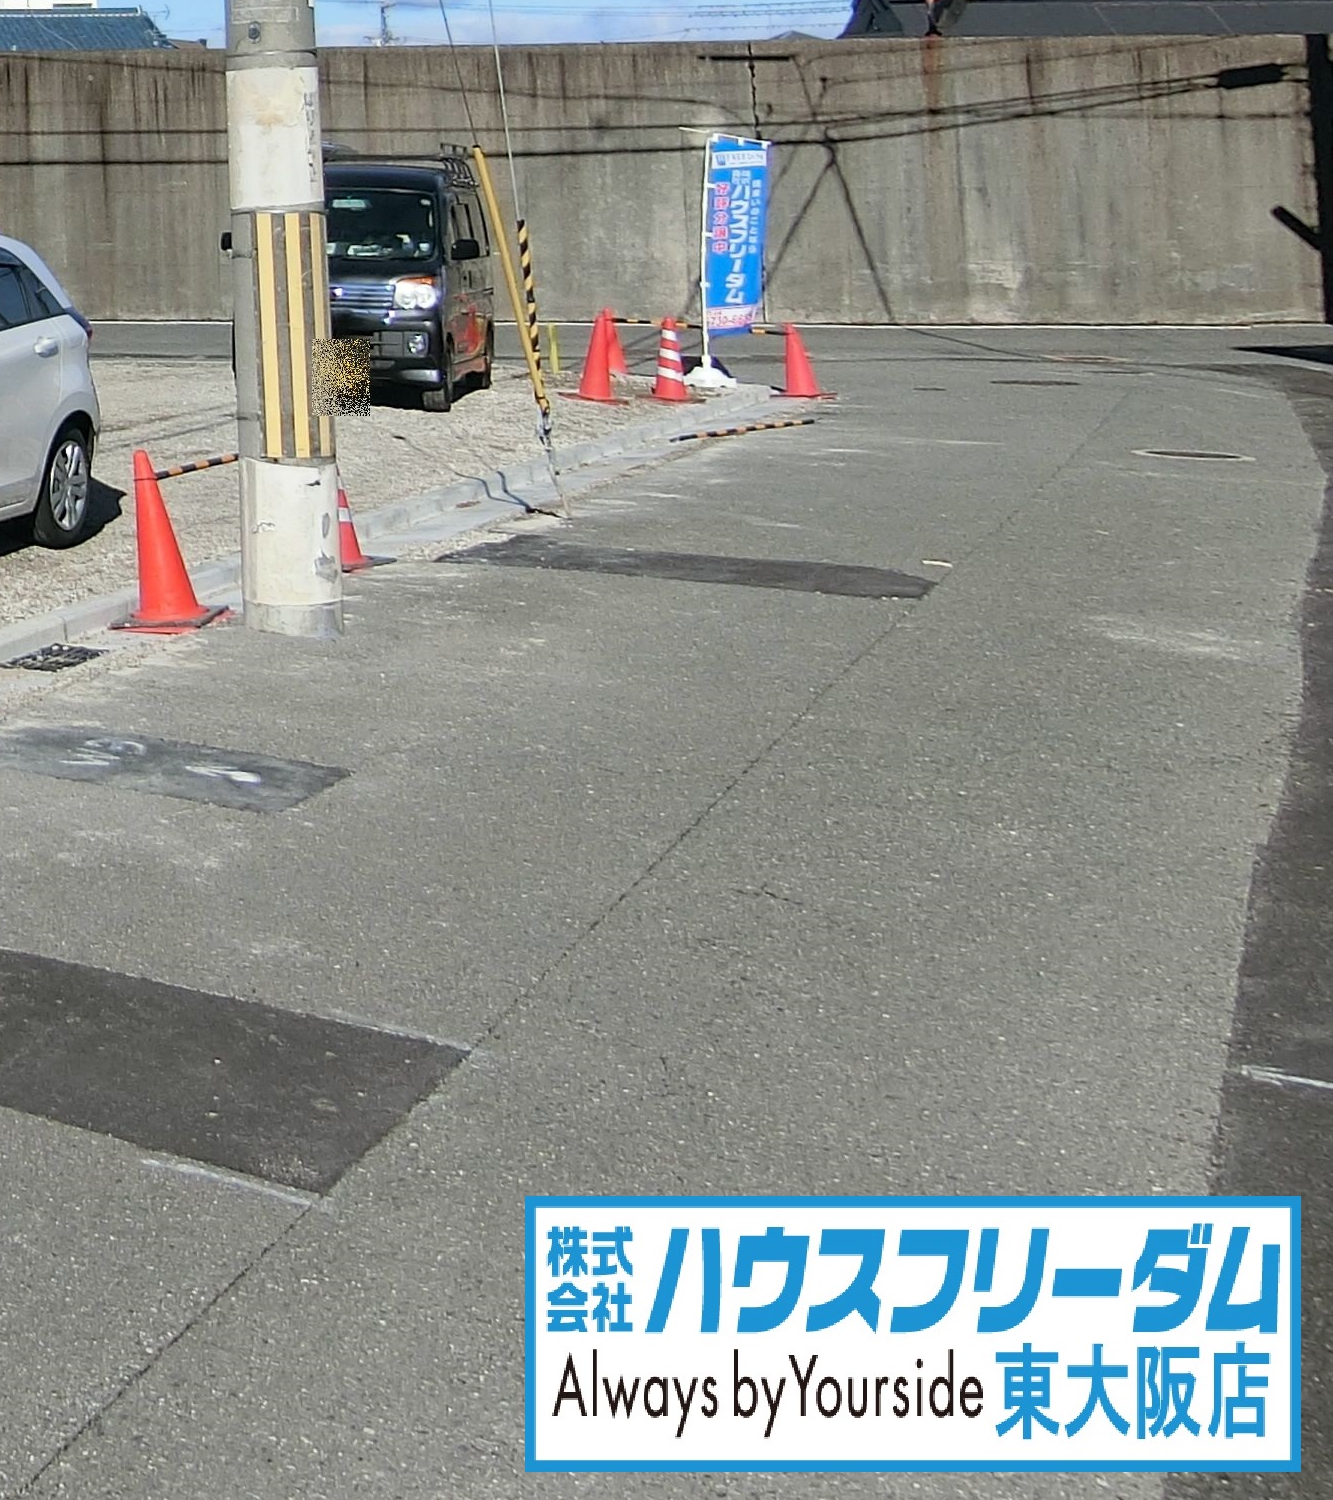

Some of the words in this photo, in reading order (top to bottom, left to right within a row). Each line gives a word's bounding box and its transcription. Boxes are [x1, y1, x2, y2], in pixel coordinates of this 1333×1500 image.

[725, 184, 750, 305] ハウスフリーダム
